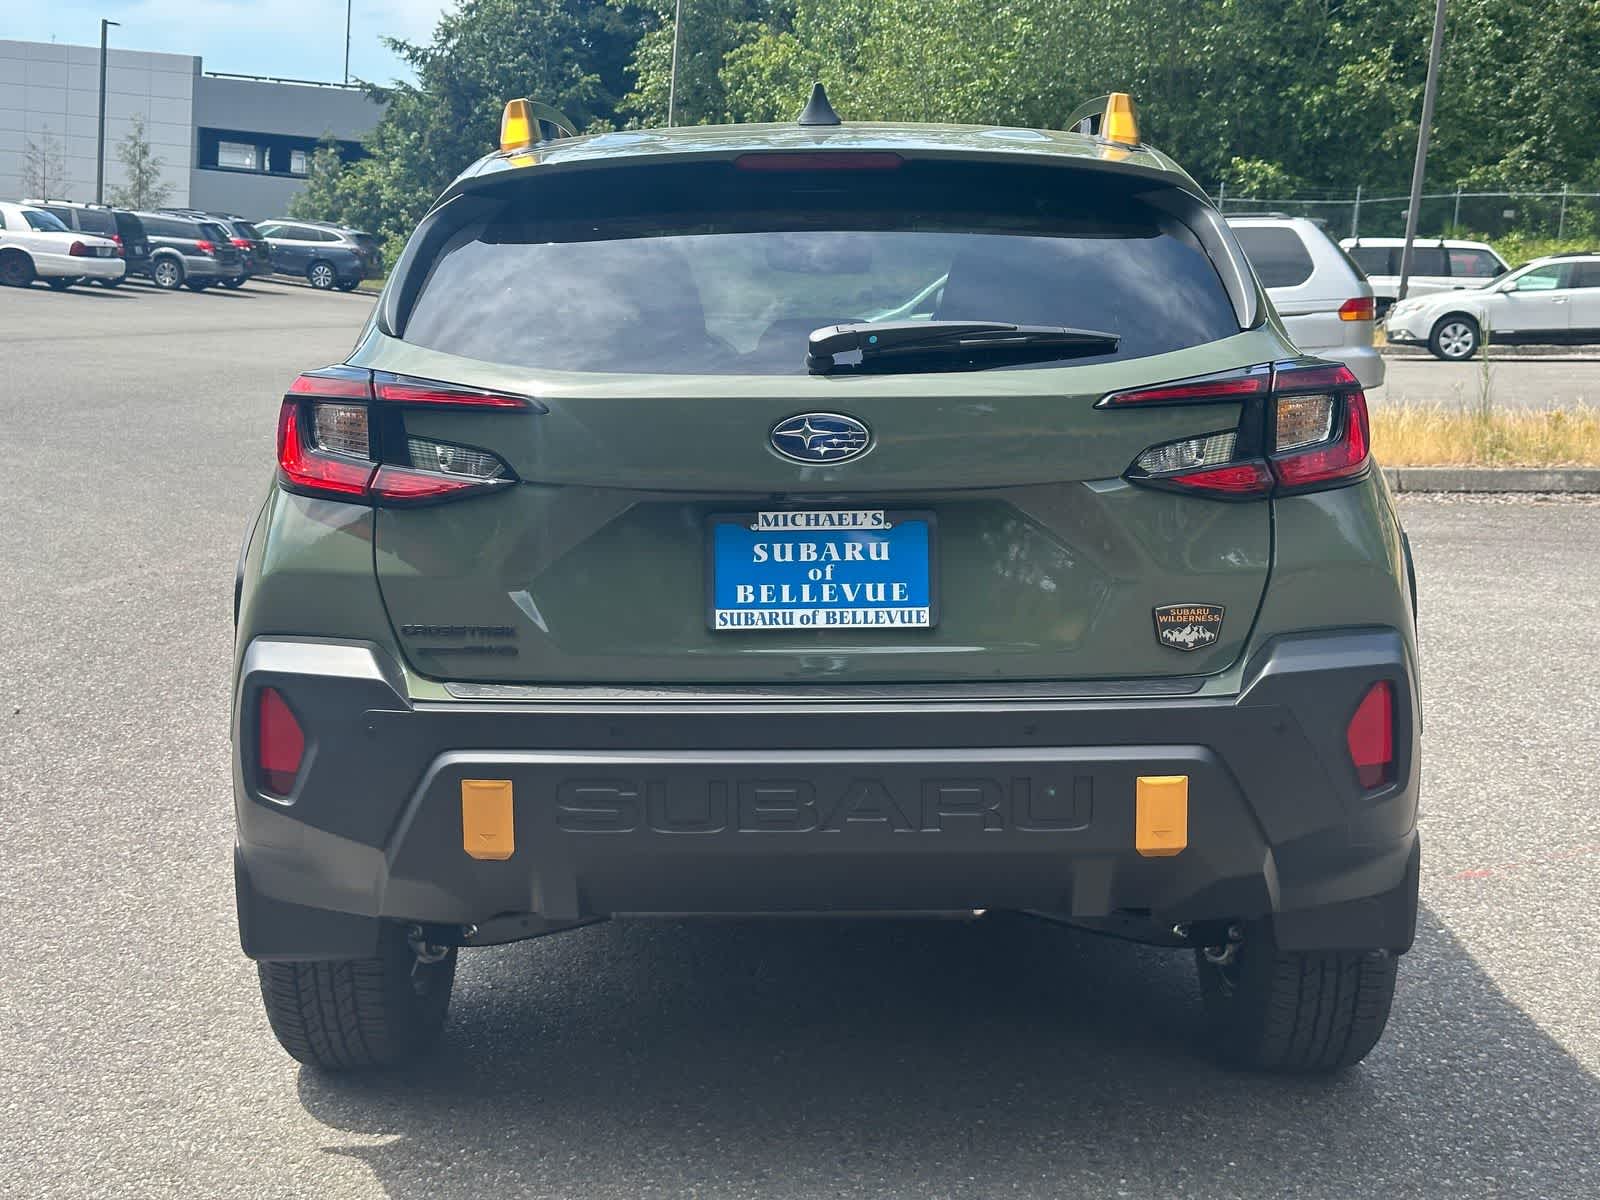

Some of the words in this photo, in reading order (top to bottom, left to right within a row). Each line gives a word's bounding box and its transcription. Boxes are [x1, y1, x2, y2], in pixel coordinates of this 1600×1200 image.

[760, 512, 883, 528] MICHAEL'S
[752, 541, 891, 563] SUBARU
[807, 563, 835, 581] of
[735, 582, 909, 604] BELLEVUE
[718, 611, 794, 627] SUBARU
[799, 610, 820, 625] of
[825, 609, 927, 625] BELLEVUE
[1159, 614, 1220, 623] WILDERNESS
[1169, 608, 1209, 616] SUBARU
[555, 776, 1095, 835] SUBARU
